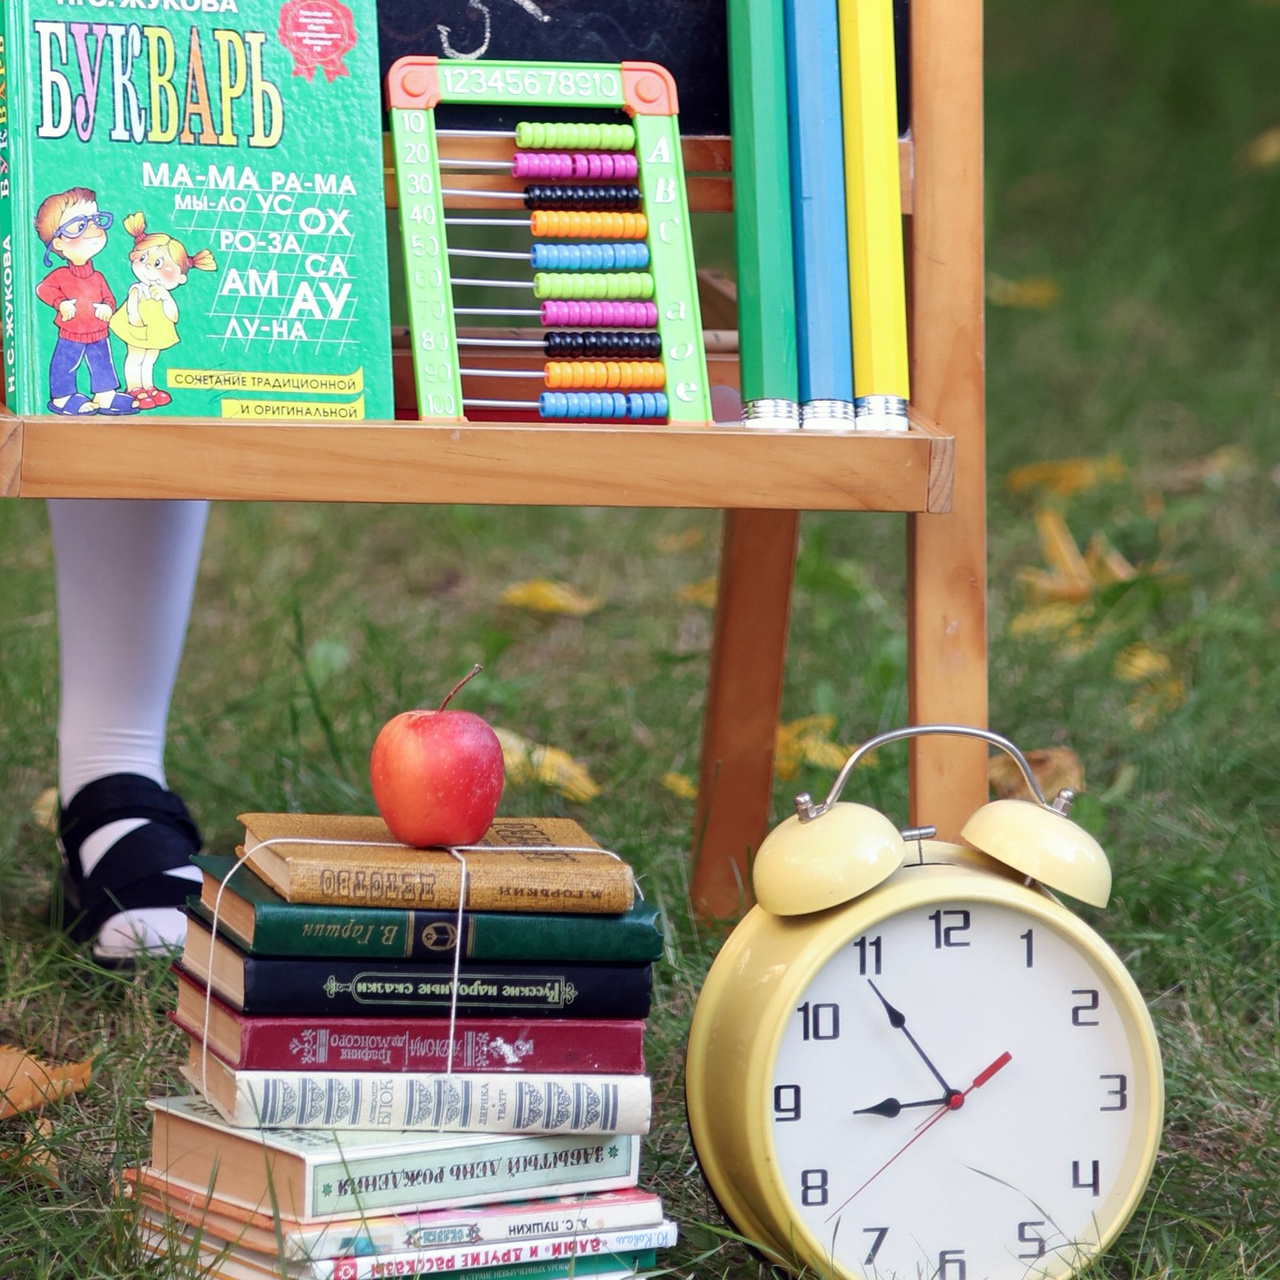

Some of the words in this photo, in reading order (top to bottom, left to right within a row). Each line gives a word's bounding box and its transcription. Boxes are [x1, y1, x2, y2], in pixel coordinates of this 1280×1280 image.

[33, 19, 284, 149] БУКВАРЬ
[402, 112, 425, 132] 10
[404, 143, 430, 164] 20
[646, 137, 671, 164] A
[142, 161, 260, 190] МА-МА
[271, 171, 357, 195] РА-МА
[407, 174, 433, 194] 30
[654, 177, 677, 203] B
[174, 194, 246, 212] МЫ-ЛО
[256, 193, 293, 215] УС
[409, 204, 436, 226] 40
[299, 207, 351, 236] ОХ
[220, 231, 302, 254] РО-ЗА
[411, 235, 440, 257] 50
[304, 254, 349, 278] СА
[2, 234, 15, 338] ЖУКОВА
[222, 268, 278, 297] АМ
[288, 281, 352, 319] АУ
[666, 299, 686, 321] a
[225, 318, 308, 340] ЛУ-НА
[421, 329, 449, 351] 80
[174, 373, 247, 387] СОЧЕТАНИЕ
[251, 377, 356, 390] ТРАДИЦИОННОЙ
[675, 378, 698, 402] e
[240, 404, 250, 415] И
[254, 405, 357, 418] ОРИГИНАЛЬНОЙ
[427, 393, 455, 415] 100
[320, 869, 436, 902] ДЕТСТВО
[302, 919, 370, 944] Гаршин
[379, 925, 399, 945] В.
[928, 909, 970, 949] 12
[853, 935, 882, 975] 11
[1020, 928, 1034, 968] 1
[356, 982, 414, 995] сказки
[418, 981, 498, 997] народные
[502, 982, 559, 1003] Русские
[1071, 989, 1099, 1026] 2
[797, 1001, 840, 1041] 10
[330, 1034, 391, 1047] МОНСОРО
[340, 1048, 391, 1064] Графиня
[377, 1079, 394, 1126] БЛОК
[479, 1082, 490, 1126] ЛИРИКА
[497, 1089, 507, 1121] ТЕАТР
[773, 1084, 801, 1122] 9
[1099, 1074, 1127, 1112] 3
[449, 1156, 502, 1178] ДЕНЬ
[507, 1145, 604, 1179] ЗАБЫТЫЙ
[336, 1165, 446, 1197] РОЖДЕНИЯ
[801, 1168, 829, 1206] 8
[1071, 1160, 1100, 1196] 4
[508, 1221, 559, 1235] ПУШКИН
[1017, 1221, 1046, 1259] 5
[862, 1226, 890, 1265] 7
